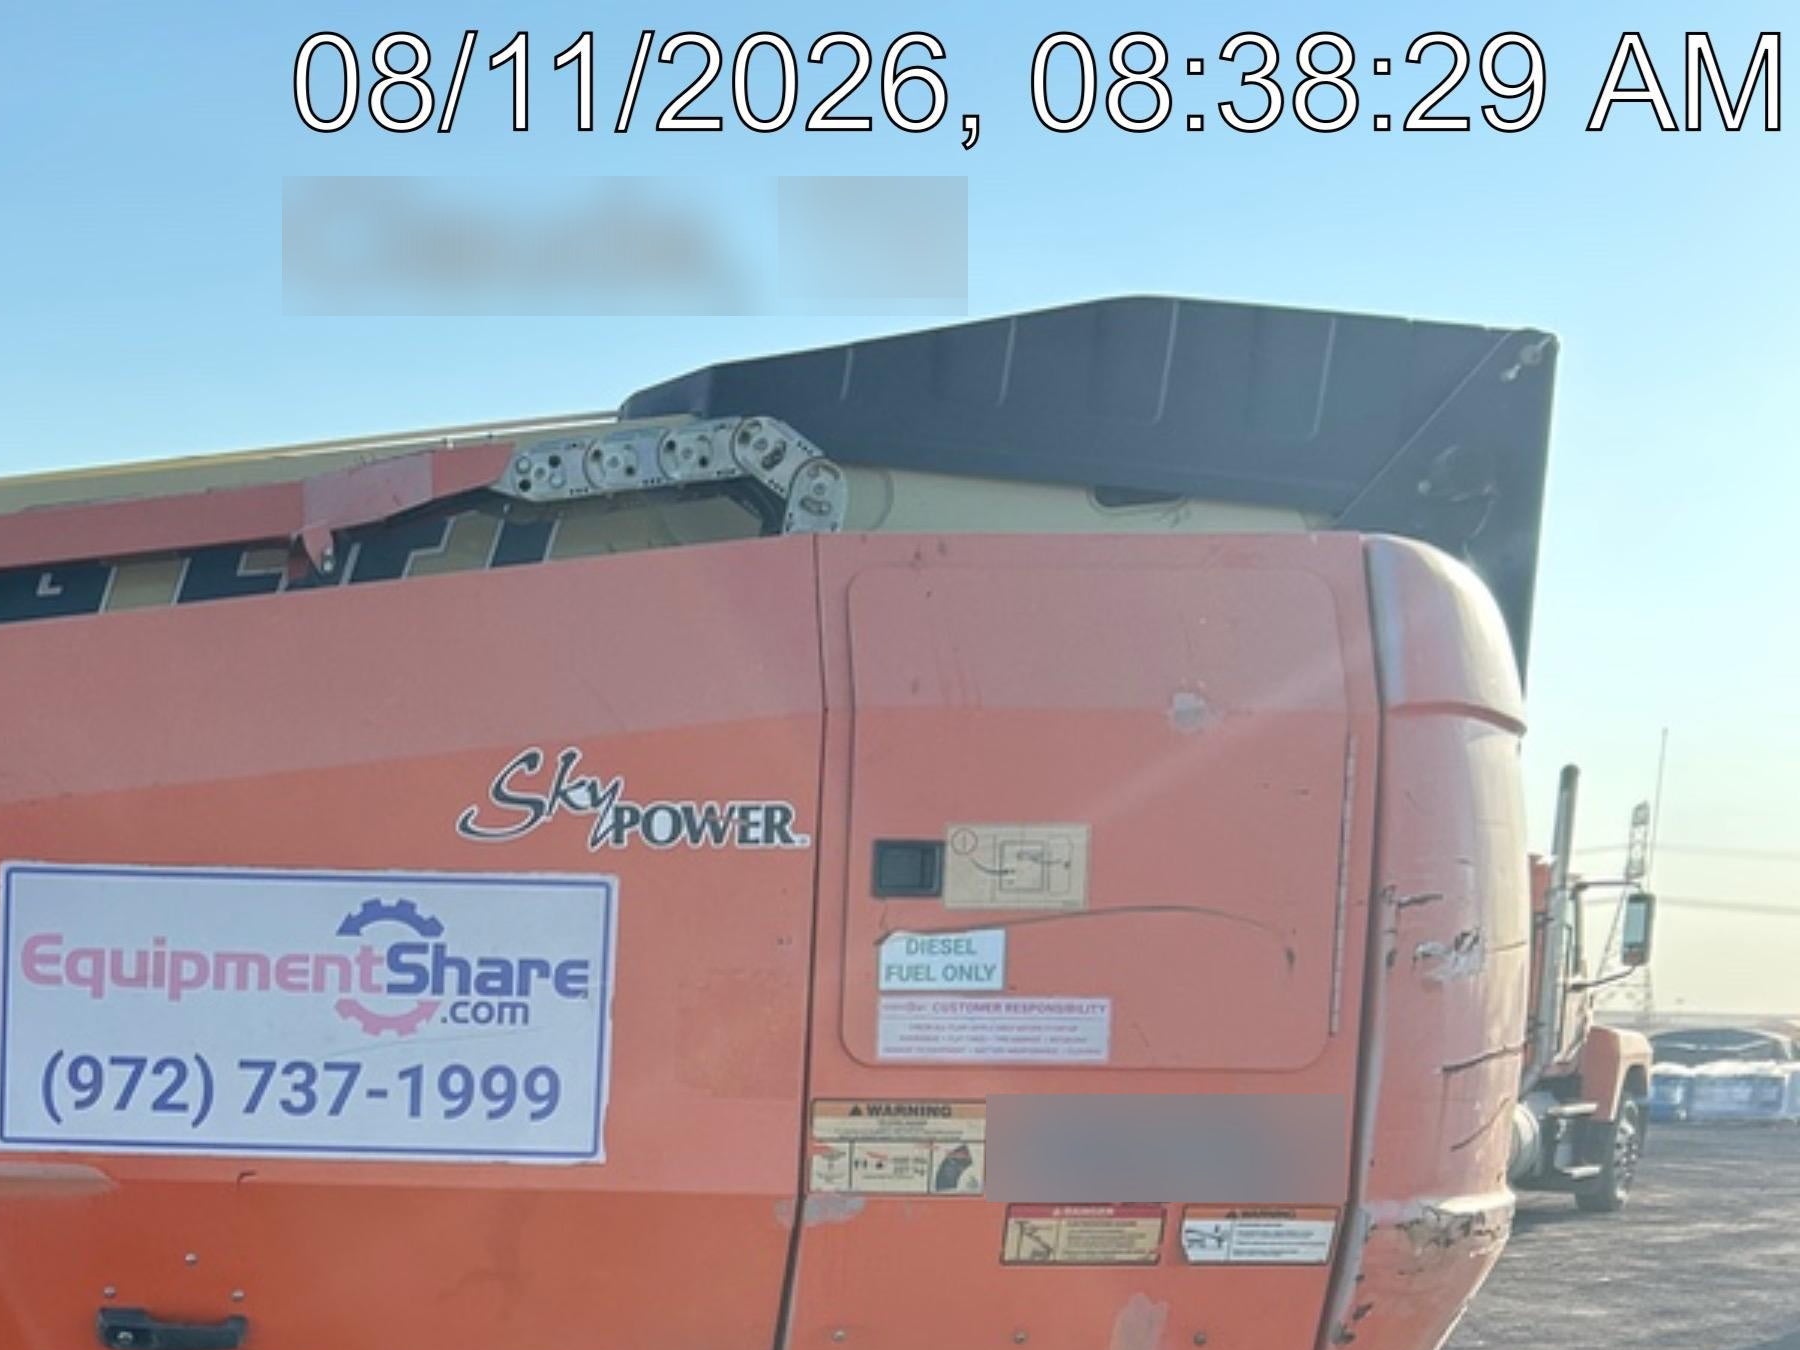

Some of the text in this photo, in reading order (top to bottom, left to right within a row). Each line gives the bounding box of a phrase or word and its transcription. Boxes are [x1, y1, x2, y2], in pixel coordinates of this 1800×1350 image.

[905, 937, 977, 954] DIESEL
[20, 933, 591, 1002] EquipmentShare
[885, 964, 997, 981] FUEL ONLY
[440, 1001, 530, 1025] .com
[932, 1002, 1001, 1014] CUSTOMER
[41, 1049, 561, 1129] (972) 737-1999
[865, 1104, 953, 1118] WARNING
